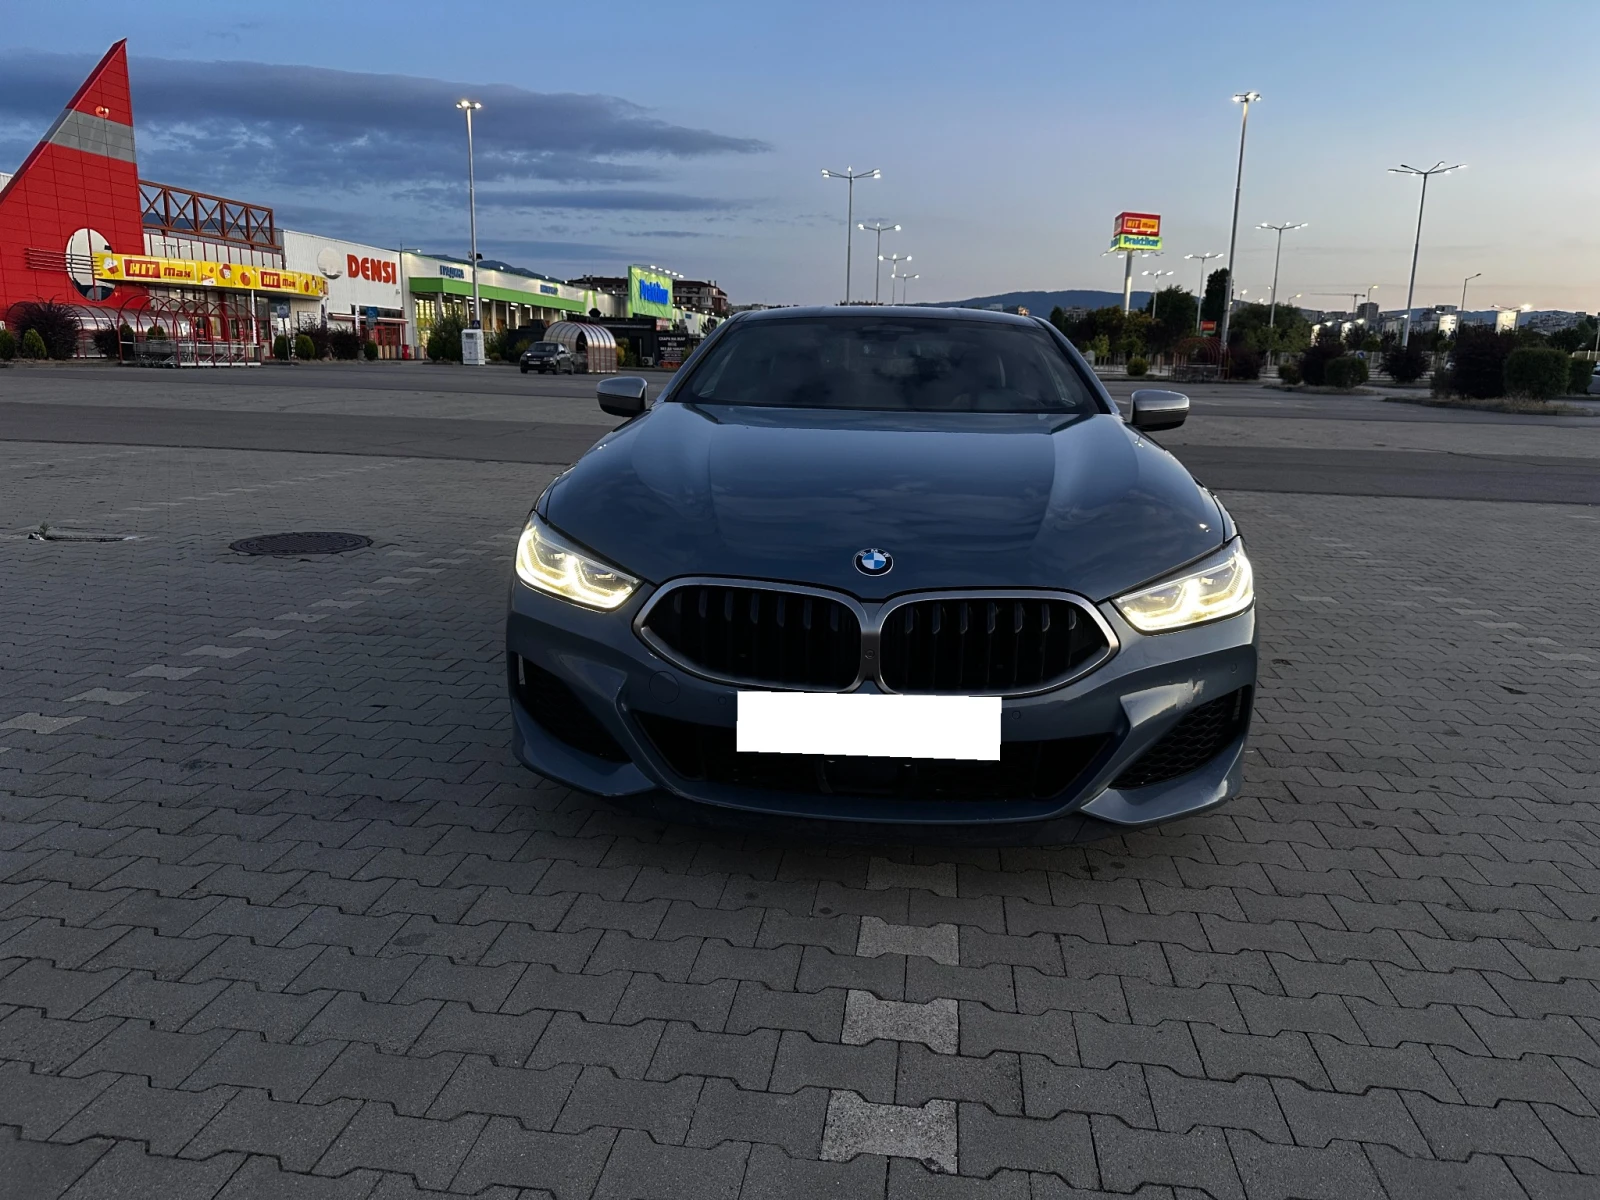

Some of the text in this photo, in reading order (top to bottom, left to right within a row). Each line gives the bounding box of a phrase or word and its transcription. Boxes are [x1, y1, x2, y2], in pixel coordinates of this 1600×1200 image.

[1126, 219, 1140, 228] HIT
[1124, 235, 1159, 247] Praktiker
[129, 262, 191, 278] HIT Max
[346, 253, 397, 285] DENSI
[262, 274, 296, 288] HIT Max
[858, 548, 891, 557] BMW
